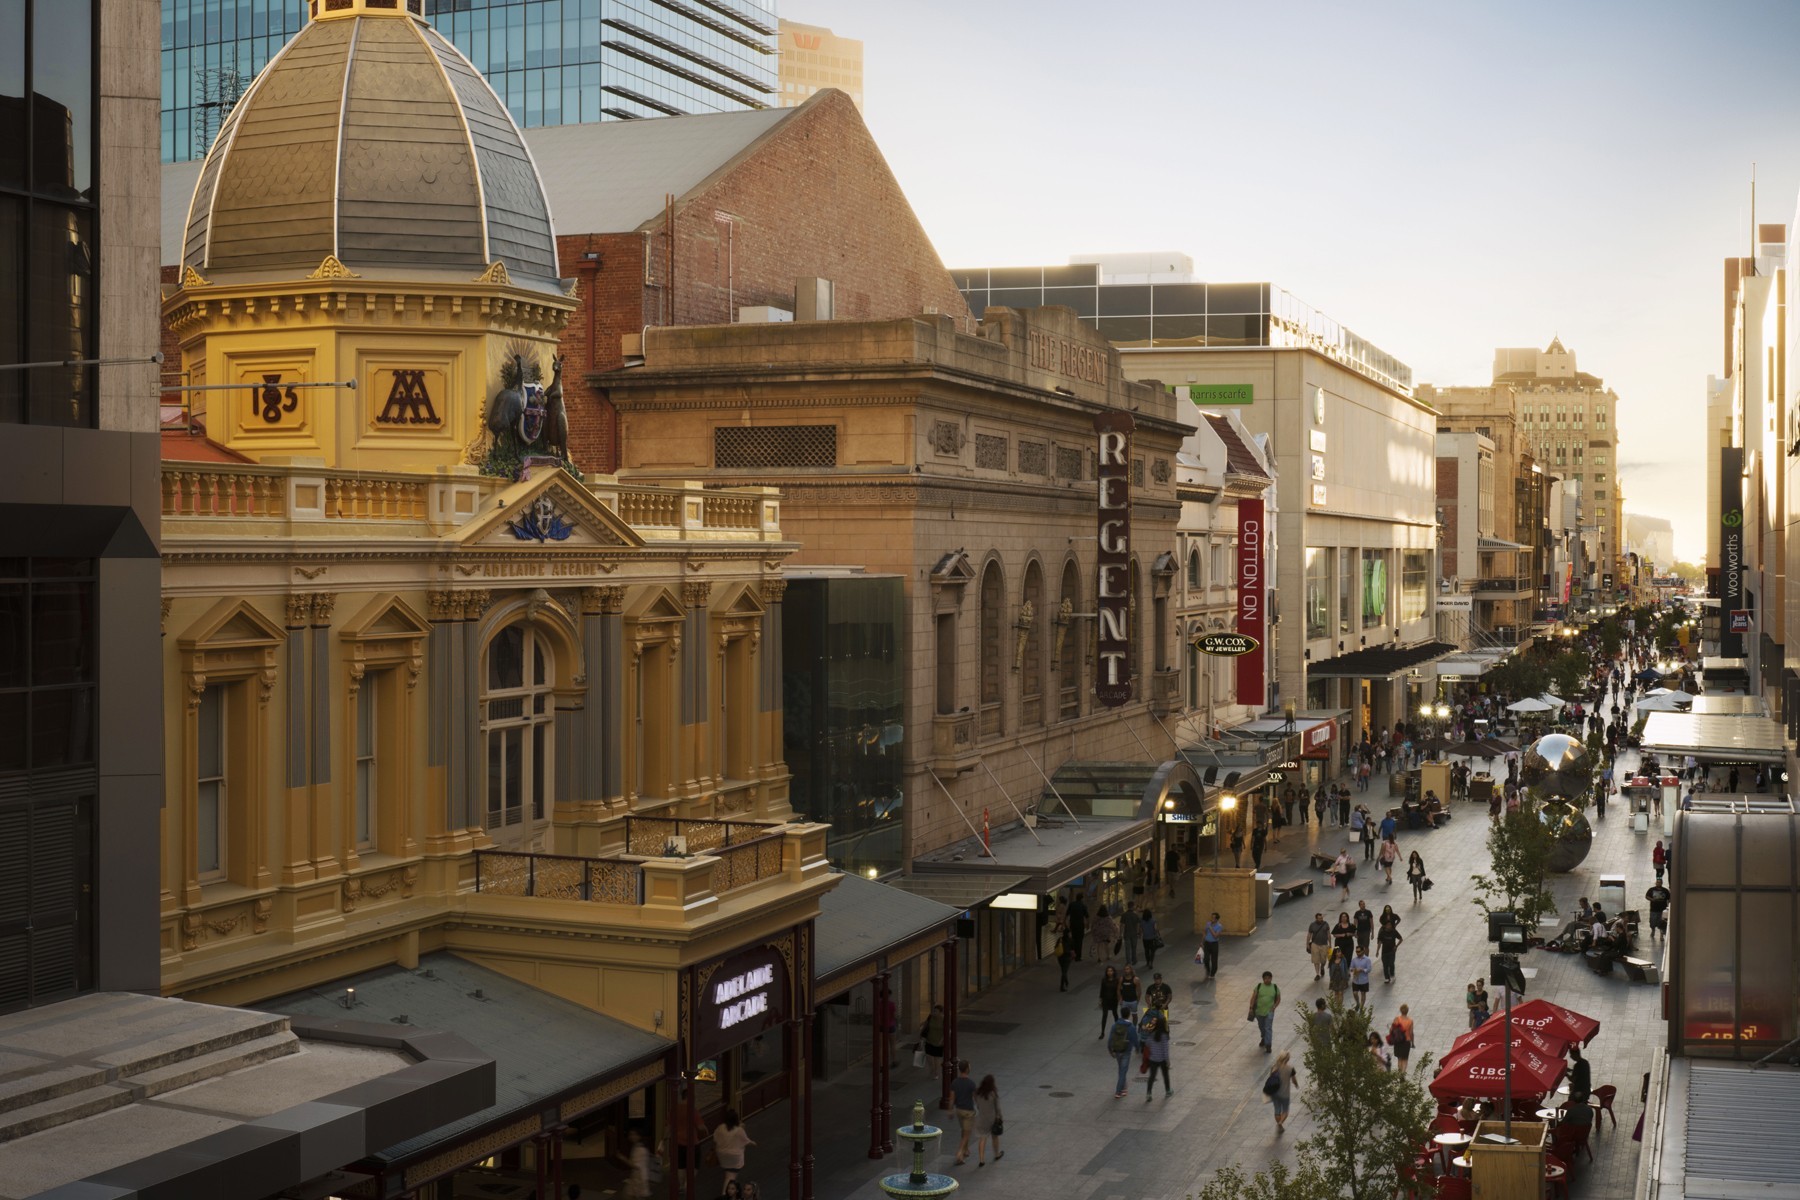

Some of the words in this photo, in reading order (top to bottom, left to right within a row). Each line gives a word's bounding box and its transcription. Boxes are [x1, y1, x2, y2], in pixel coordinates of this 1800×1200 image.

[1029, 330, 1056, 372] THE
[1060, 340, 1108, 386] REGENT
[1190, 389, 1216, 399] harris
[1218, 389, 1247, 399] scarfe
[483, 562, 546, 577] ADELAIDE
[551, 562, 598, 576] ARCADE
[1099, 431, 1128, 686] REGENT
[1243, 521, 1259, 589] COTTON
[1243, 595, 1258, 620] ON
[1171, 813, 1197, 821] SHIELS
[714, 963, 774, 1005] ADELAIDE
[720, 992, 768, 1029] ARCADE
[1511, 1017, 1546, 1027] CIBO
